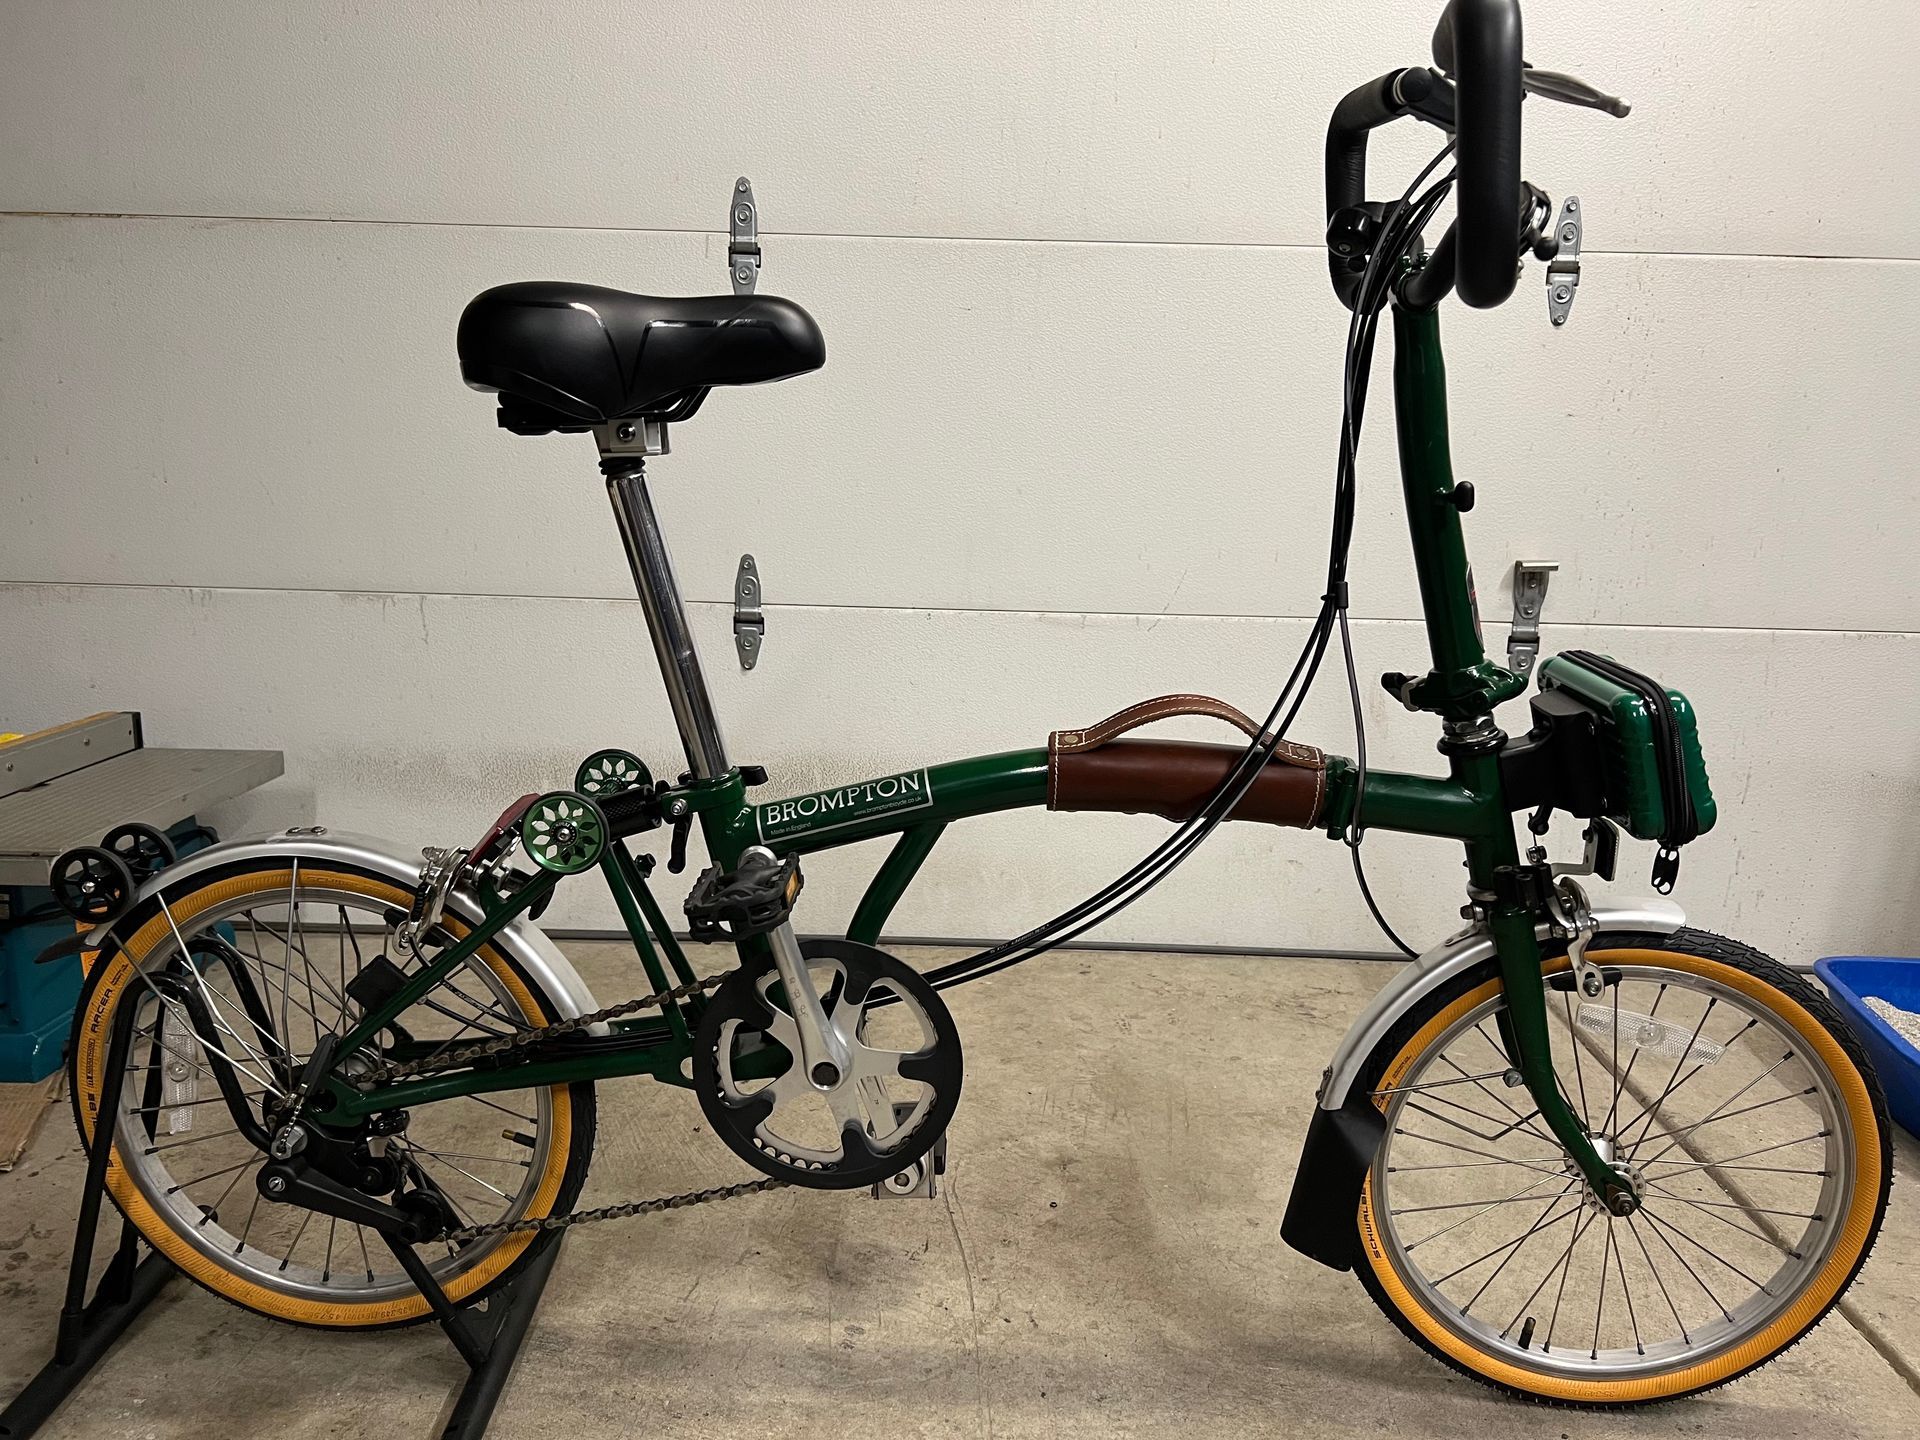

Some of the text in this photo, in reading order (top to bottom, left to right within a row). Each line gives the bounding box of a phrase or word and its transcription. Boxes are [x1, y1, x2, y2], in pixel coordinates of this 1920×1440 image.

[766, 773, 920, 825] BROMPTON
[770, 826, 785, 836] Made
[791, 822, 812, 833] England
[90, 987, 114, 1035] RACER
